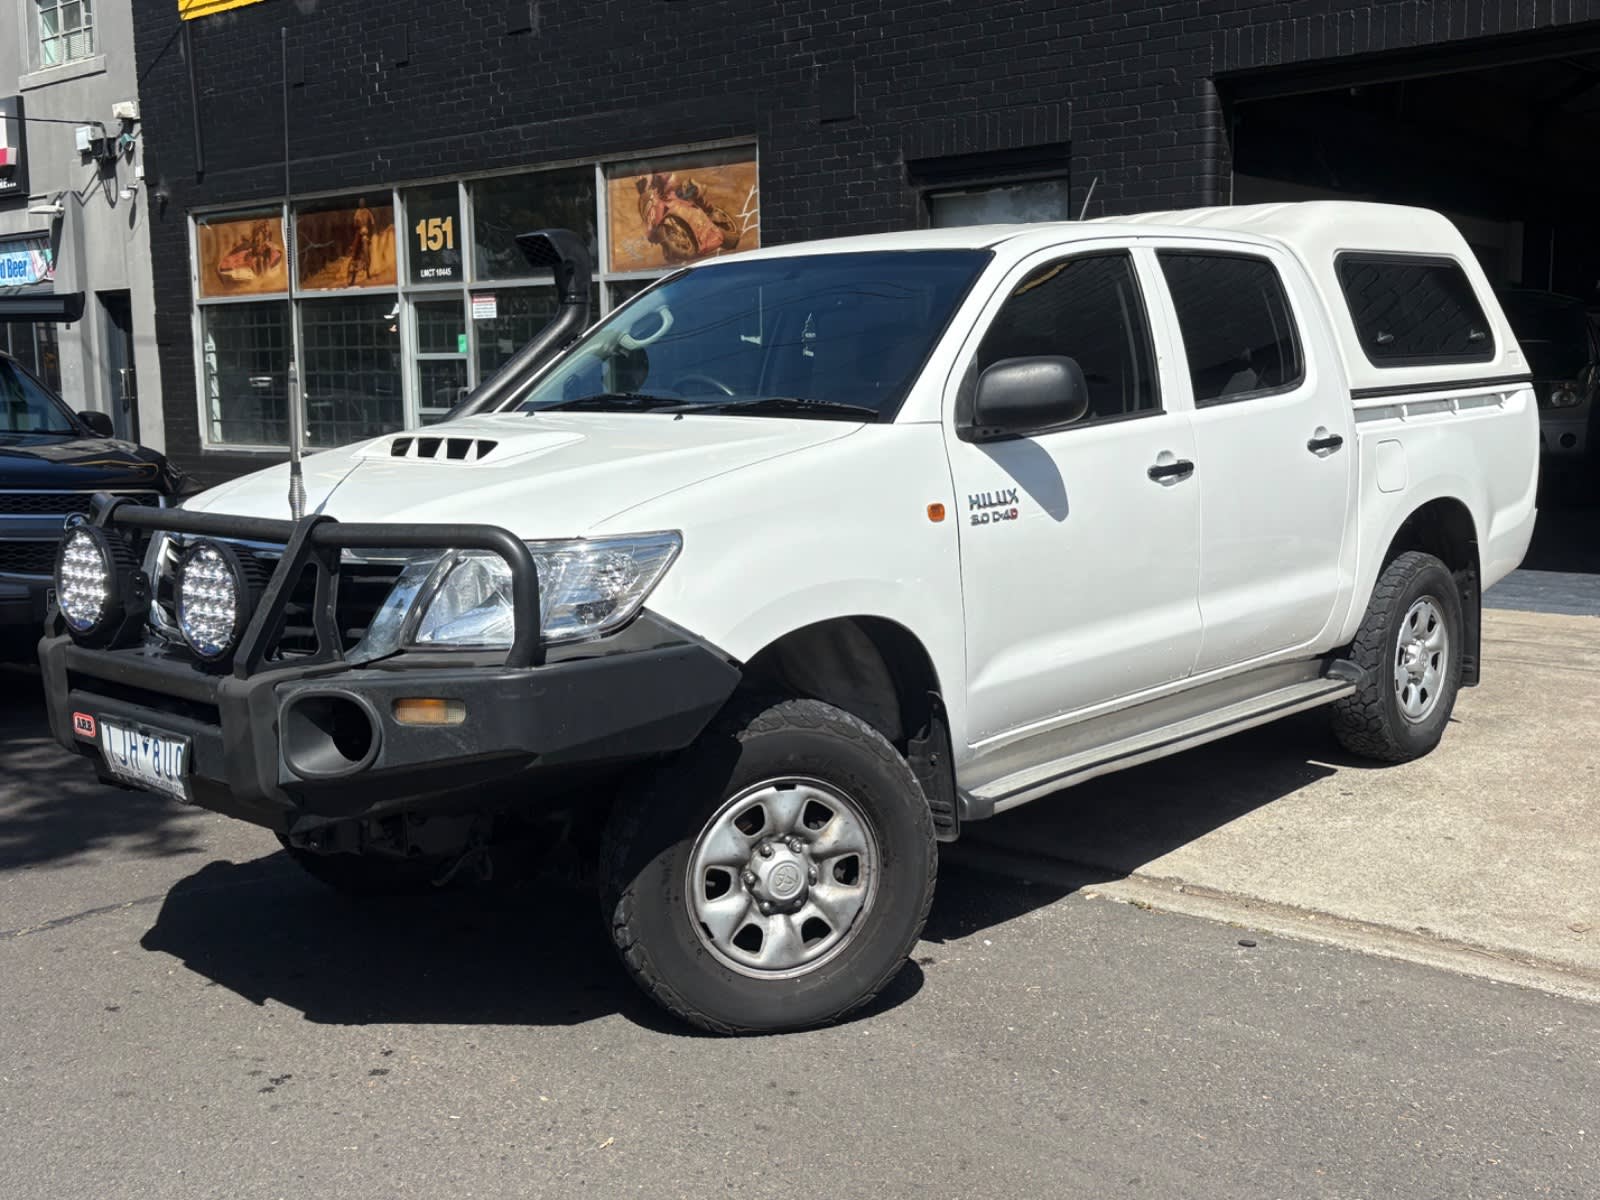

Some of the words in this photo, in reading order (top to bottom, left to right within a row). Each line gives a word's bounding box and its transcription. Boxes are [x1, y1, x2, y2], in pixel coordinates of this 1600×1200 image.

[415, 216, 454, 252] 151
[7, 258, 27, 278] Beer
[420, 268, 436, 278] LMCT
[968, 488, 1019, 511] HILUX
